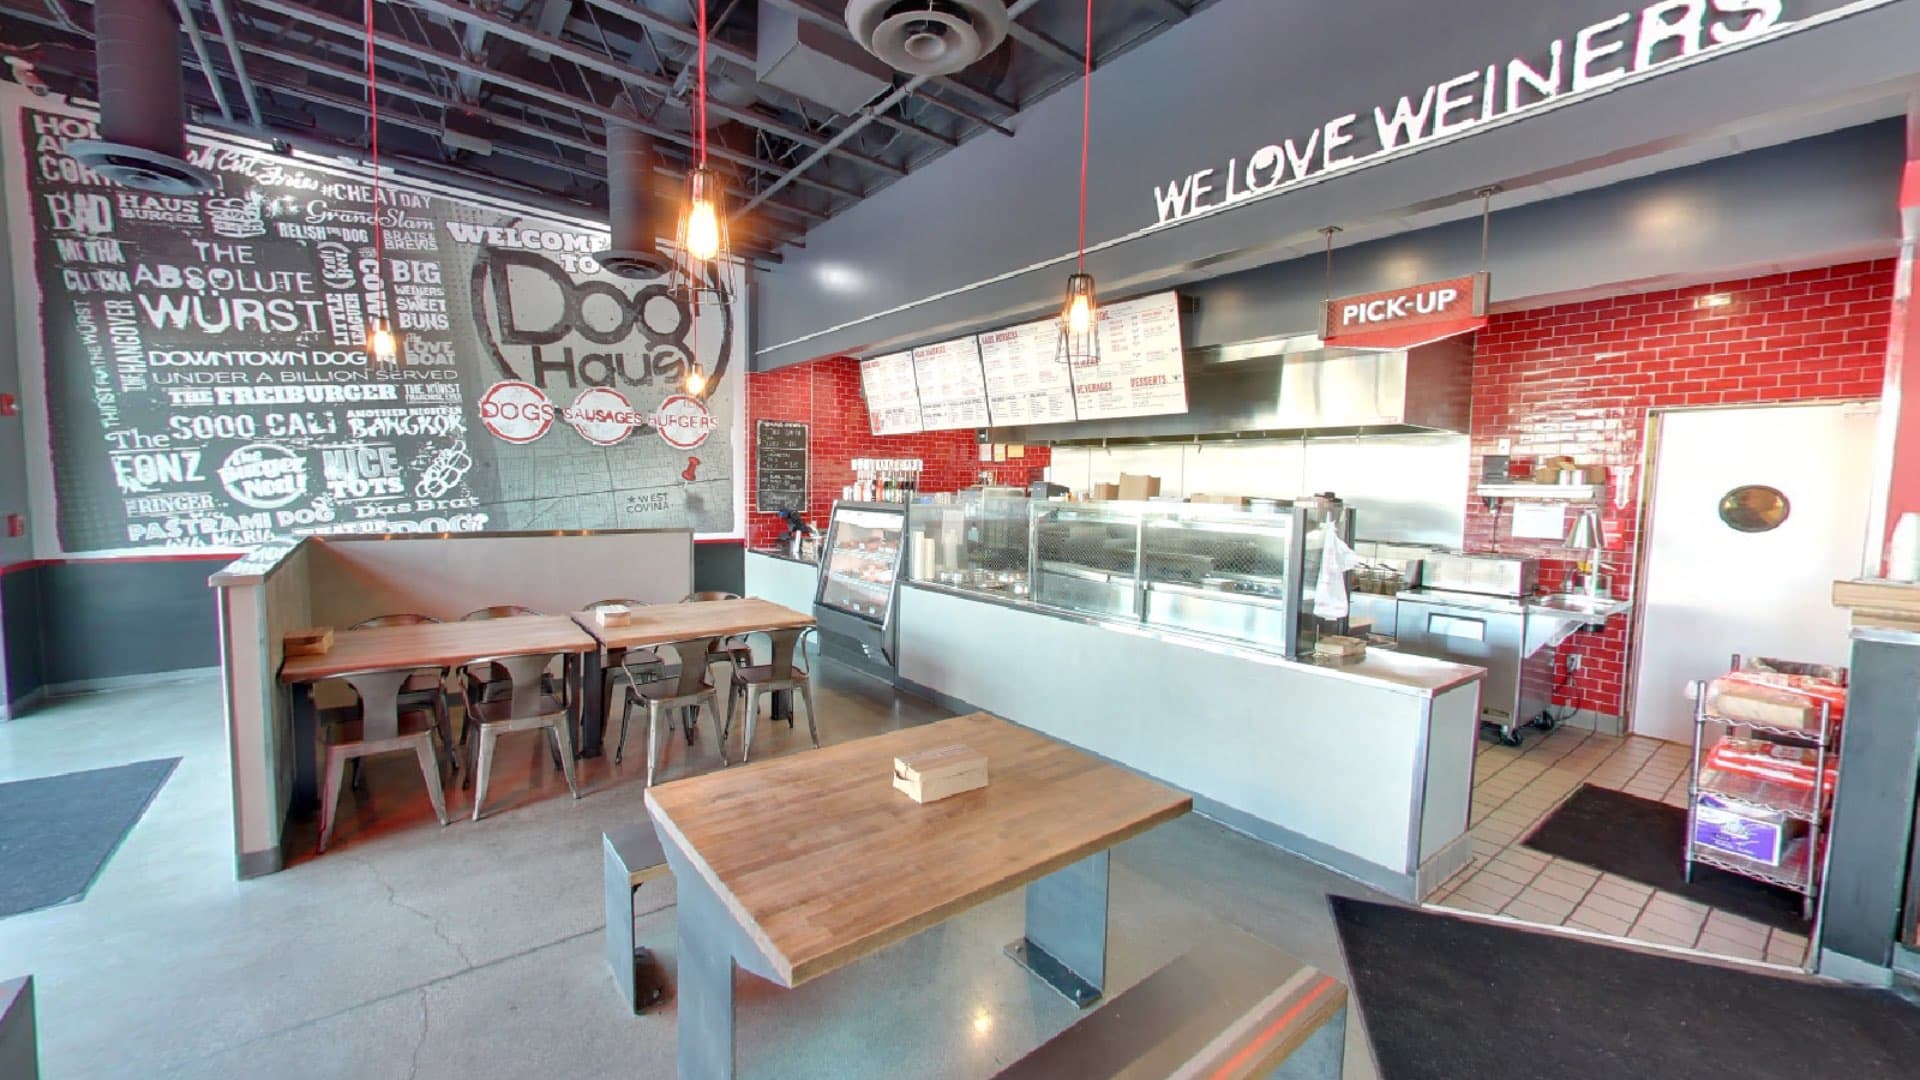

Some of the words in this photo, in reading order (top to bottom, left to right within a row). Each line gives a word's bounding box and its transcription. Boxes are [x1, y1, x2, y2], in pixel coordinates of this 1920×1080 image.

[1154, 168, 1213, 224] WE
[1225, 113, 1356, 203] LOVE
[1374, 0, 1783, 150] WEINERS
[117, 194, 200, 214] HAUS
[119, 209, 202, 225] BURGER
[279, 221, 328, 240] RELISH
[342, 227, 369, 243] DOG
[446, 221, 611, 252] WELCOME
[191, 237, 256, 265] THE
[392, 260, 441, 285] BIG
[560, 250, 602, 275] TO
[133, 263, 316, 294] ABSOLUTE
[137, 287, 324, 334] WÜRST
[396, 296, 447, 313] SWEET
[1343, 288, 1457, 326] PICK-UP
[325, 292, 350, 346] LITTLE
[398, 311, 450, 332] BUNS
[103, 300, 148, 373] HANGOVER
[148, 350, 308, 367] DOWNTOWN
[312, 350, 368, 366] DOG
[403, 341, 454, 355] LOVE
[405, 352, 457, 366] BOAT
[152, 371, 249, 385] UNDER
[255, 371, 274, 384] A
[280, 370, 369, 383] BILLION
[375, 369, 459, 381] SERVED
[532, 344, 688, 389] Haus
[167, 388, 214, 406] THE
[213, 384, 398, 406] FREIBURGER
[480, 402, 556, 422] DOGS
[564, 405, 643, 425] SAUSAGES
[168, 414, 256, 441] SOOO
[265, 410, 337, 437] CALI
[347, 415, 468, 439] BANGKOK
[104, 428, 171, 449] The
[110, 450, 206, 488] FONZ
[321, 446, 401, 480] NICE
[327, 477, 405, 499] TOTS
[638, 492, 669, 503] WEST
[138, 495, 216, 514] RINGER
[355, 503, 413, 519] Das
[415, 496, 480, 514] Brat
[626, 500, 669, 514] COVINA
[127, 510, 272, 542] PASTRAMI
[276, 507, 335, 528] DOG
